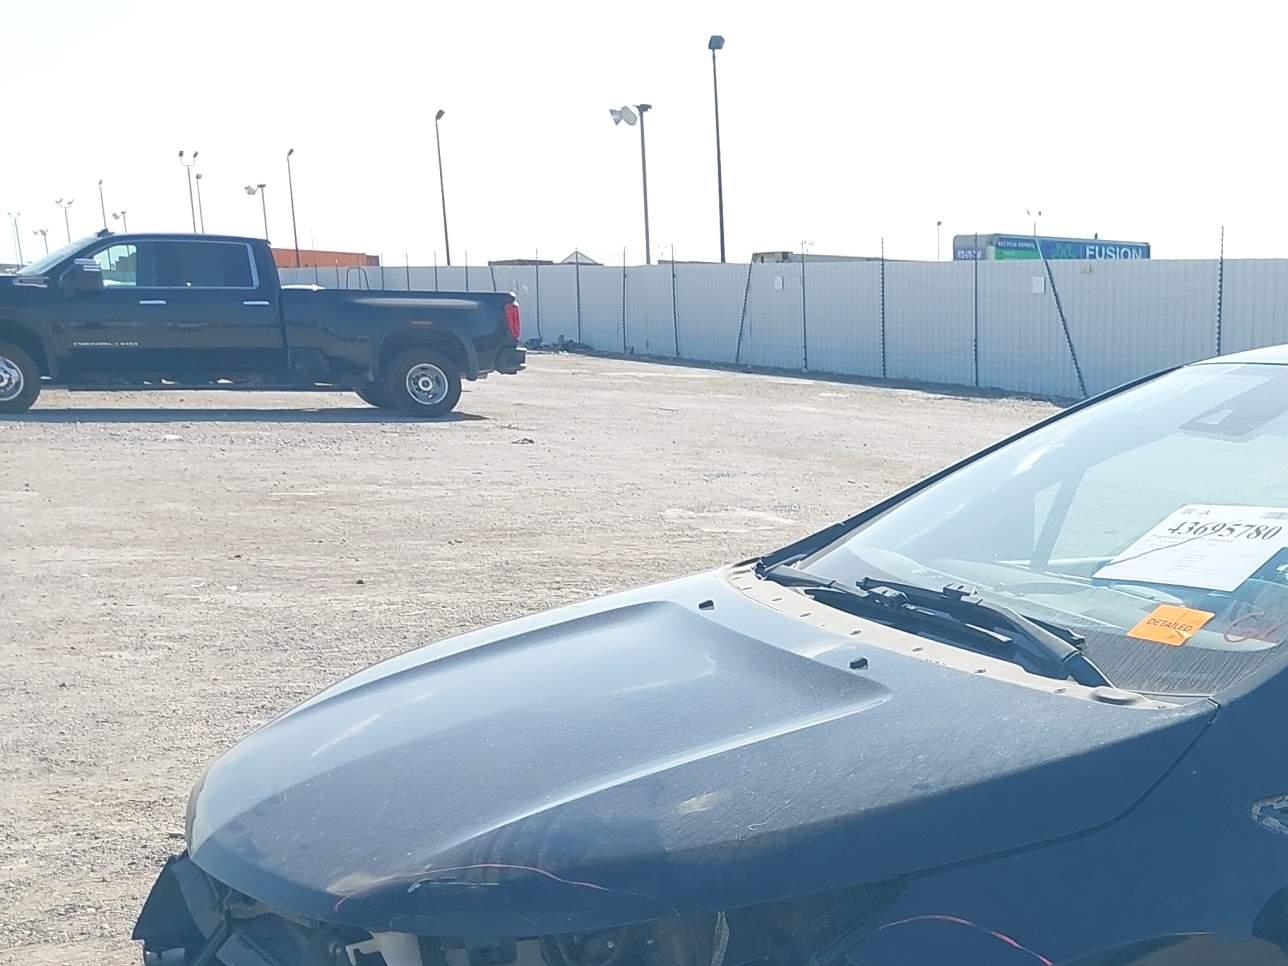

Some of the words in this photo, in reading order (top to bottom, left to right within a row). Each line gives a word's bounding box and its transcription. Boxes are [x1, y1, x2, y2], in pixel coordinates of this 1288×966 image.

[1086, 245, 1142, 260] FUSION
[1168, 520, 1283, 541] 43695780
[1146, 617, 1193, 633] DETAILED
